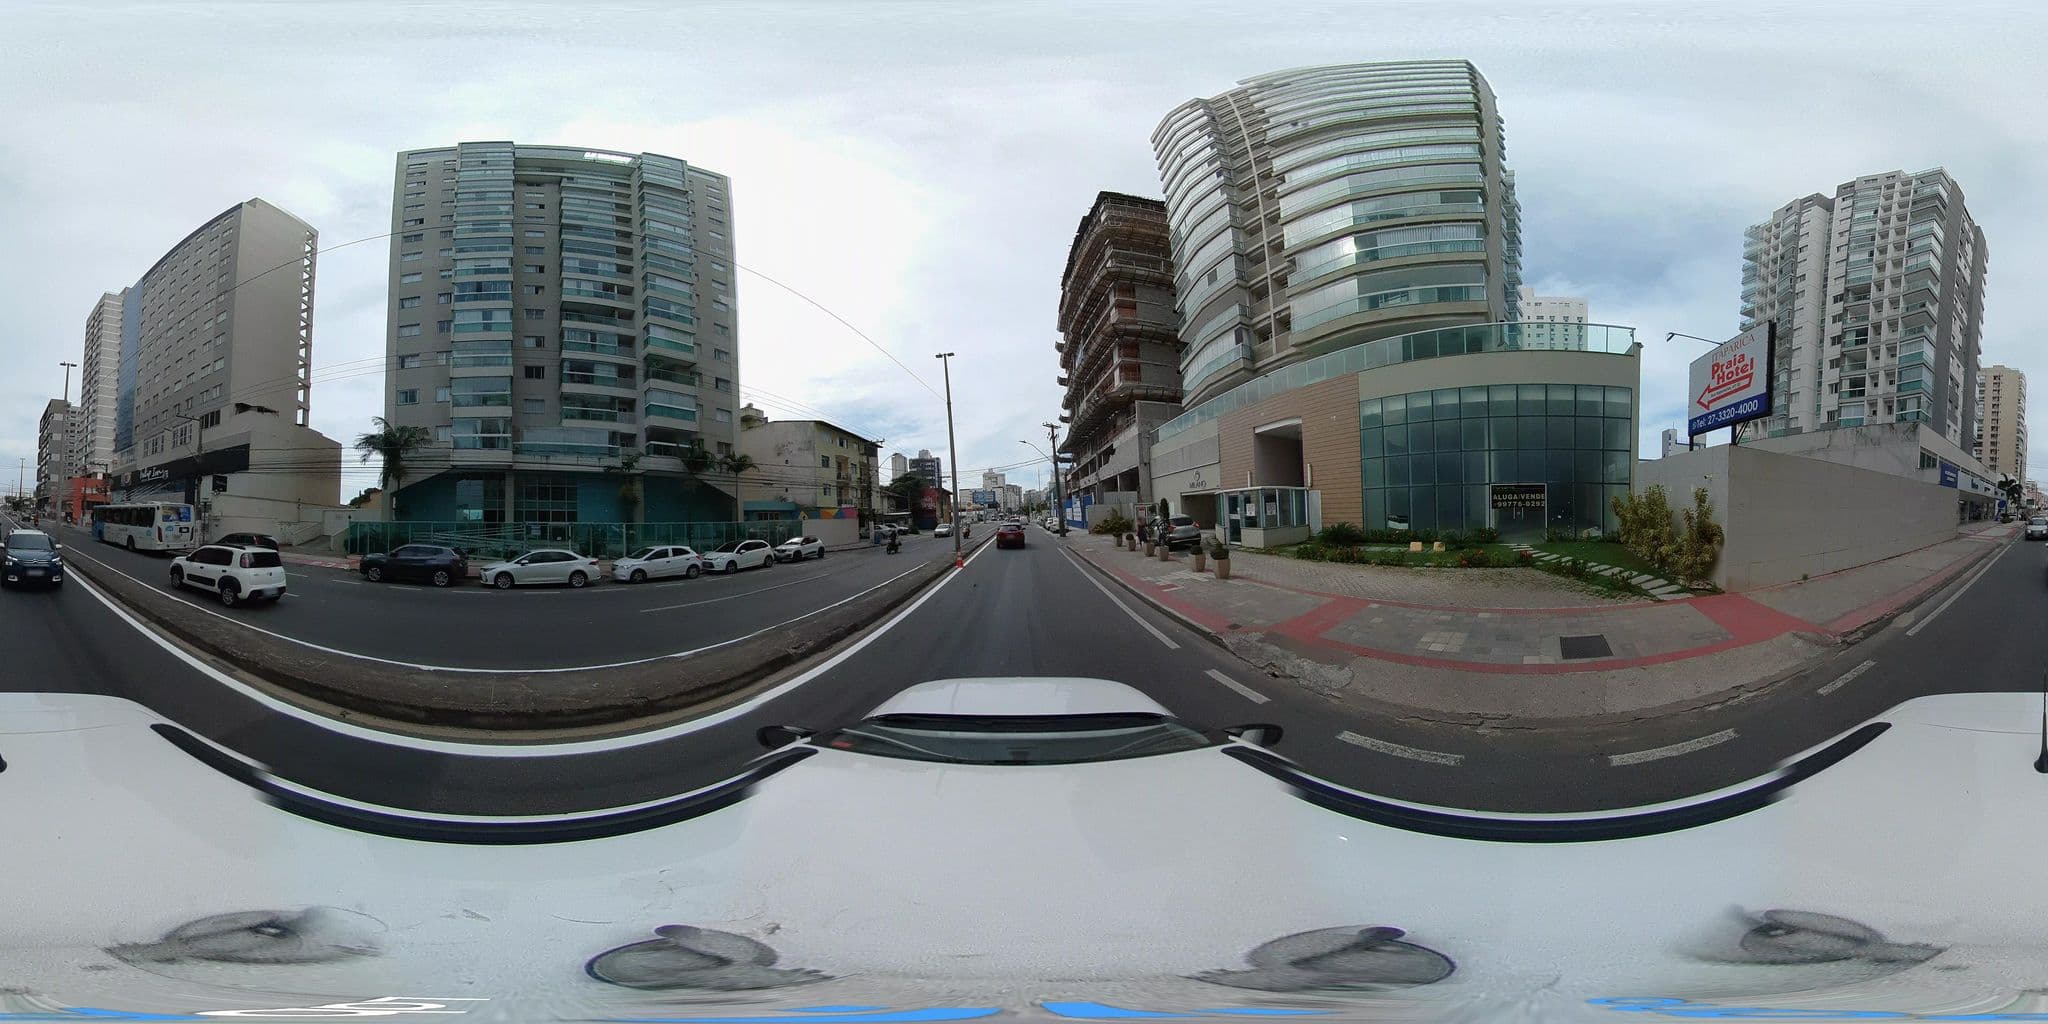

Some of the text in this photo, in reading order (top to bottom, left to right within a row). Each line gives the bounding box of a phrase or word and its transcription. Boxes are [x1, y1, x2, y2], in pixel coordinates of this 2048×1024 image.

[1712, 334, 1755, 361] ITAPARICA
[1711, 353, 1746, 380] Praia
[1716, 357, 1754, 385] Hotel
[1707, 399, 1758, 425] 27-3320-4000
